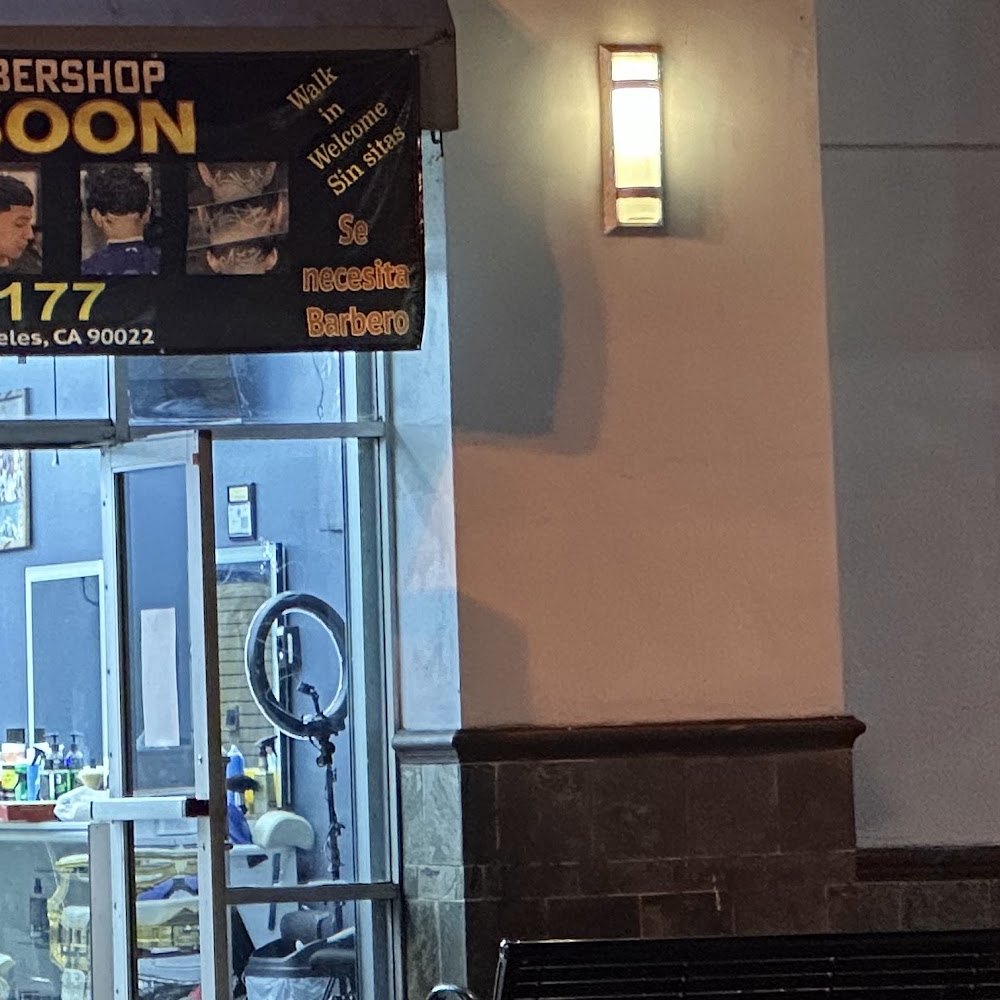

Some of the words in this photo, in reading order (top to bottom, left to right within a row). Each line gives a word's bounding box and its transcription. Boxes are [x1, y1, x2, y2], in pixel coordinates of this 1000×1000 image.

[286, 67, 339, 110] Walk
[318, 102, 345, 125] in
[306, 101, 388, 170] Welcome
[327, 164, 365, 196] Sin
[362, 126, 405, 168] sitas
[338, 213, 369, 246] Se
[302, 258, 410, 292] necesita
[53, 328, 82, 346] CA
[87, 328, 154, 346] 90022
[306, 306, 410, 338] Barbero
